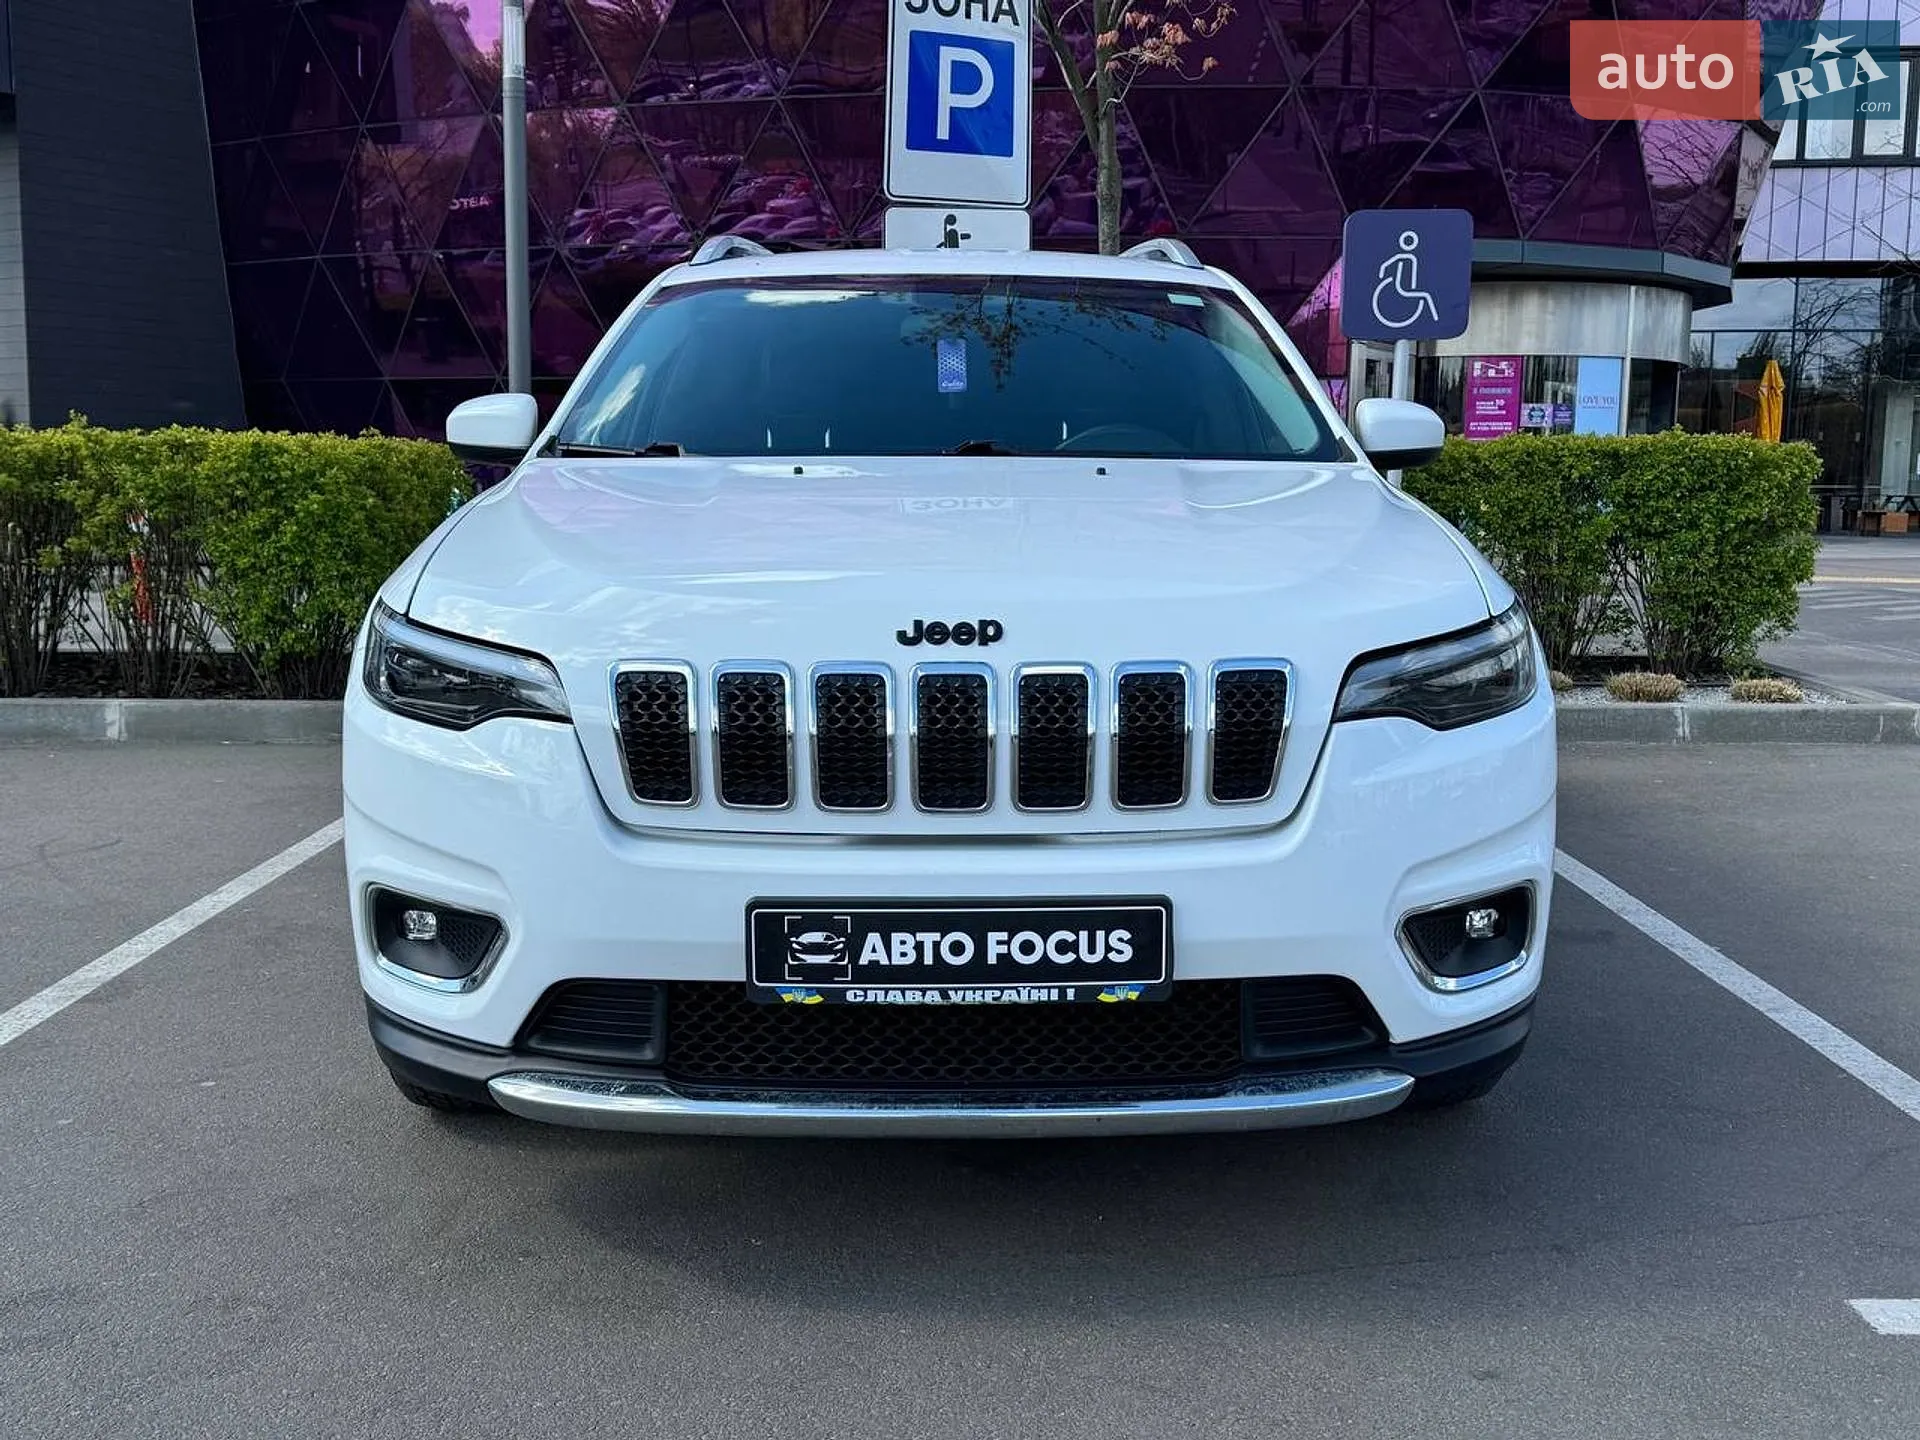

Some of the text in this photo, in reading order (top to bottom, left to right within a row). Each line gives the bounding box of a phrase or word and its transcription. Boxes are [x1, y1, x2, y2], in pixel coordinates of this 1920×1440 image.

[936, 45, 994, 140] P
[896, 619, 1004, 646] Jeep
[858, 929, 1133, 965] АВТО FOCUS
[845, 988, 943, 1004] СЛАВА
[947, 986, 1059, 1003] УКРАЇНІ
